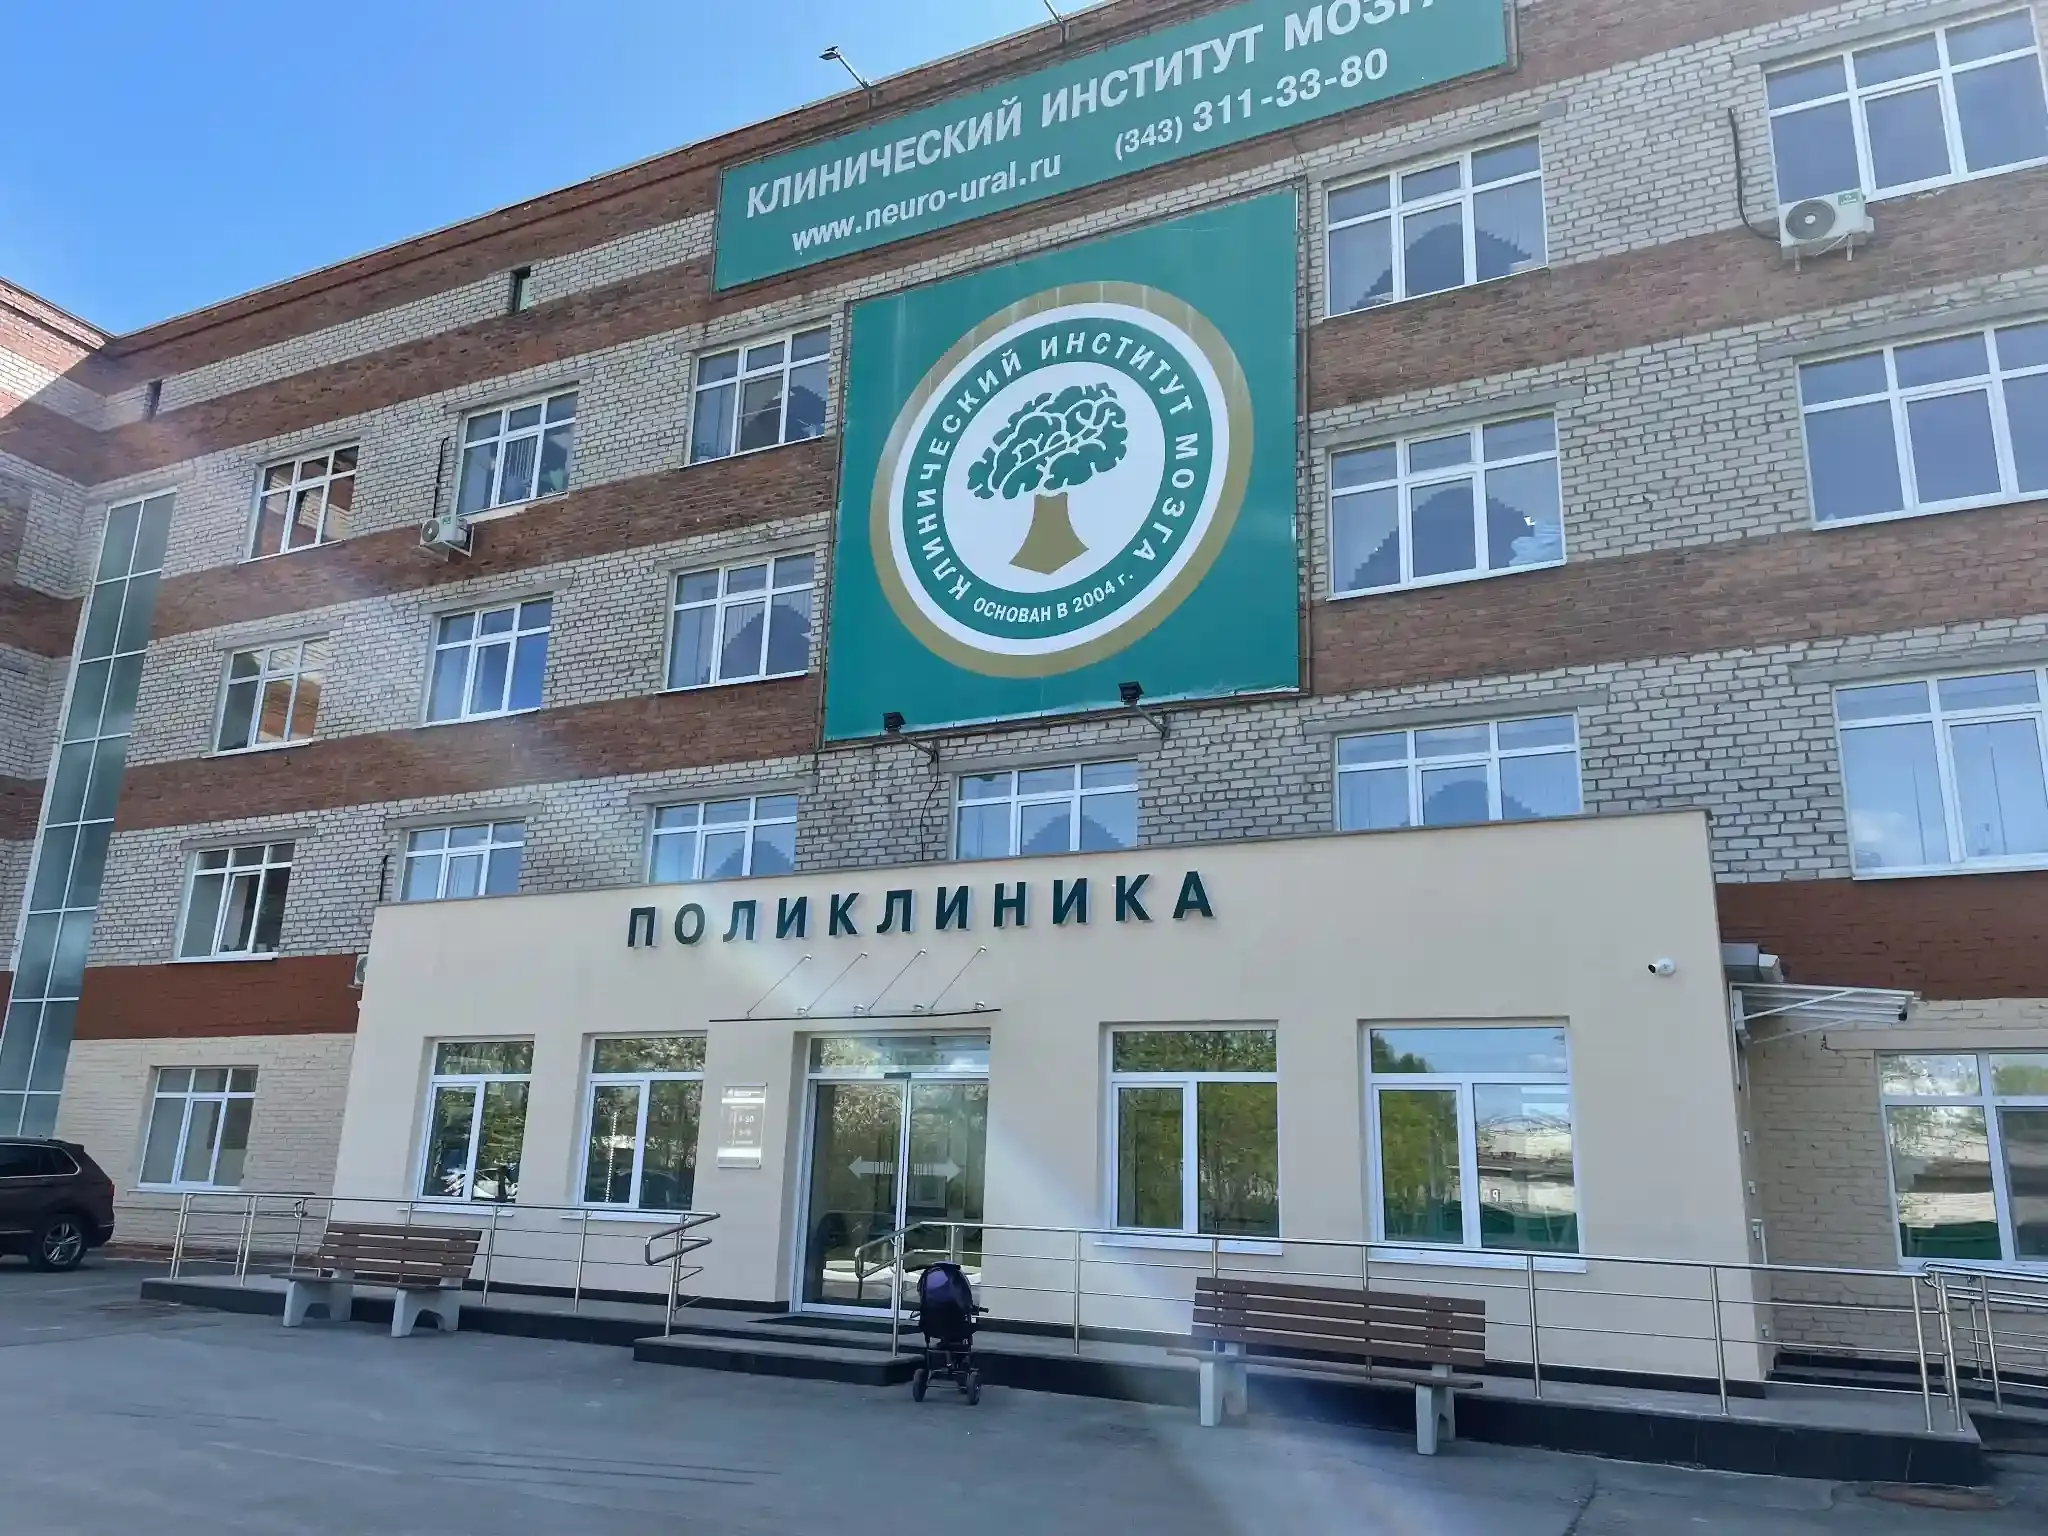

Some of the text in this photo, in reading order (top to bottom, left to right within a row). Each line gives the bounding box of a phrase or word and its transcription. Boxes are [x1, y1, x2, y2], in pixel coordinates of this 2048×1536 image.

[746, 0, 1434, 218] КЛИНИЧЕСКИЙ ИНСТИТУТ МОЗ
[1115, 48, 1388, 161] (343) 311-33-80
[791, 154, 1062, 251] www.neuro-ural.ru
[916, 332, 1199, 600] КЛИНИЧЕСКИЙ ИНСТИТУТ МОЗГА
[973, 597, 1051, 623] ОСНОВАН
[1057, 603, 1068, 619] В
[1074, 582, 1116, 613] 2004
[627, 871, 1214, 948] ПОЛИКЛИНИКА
